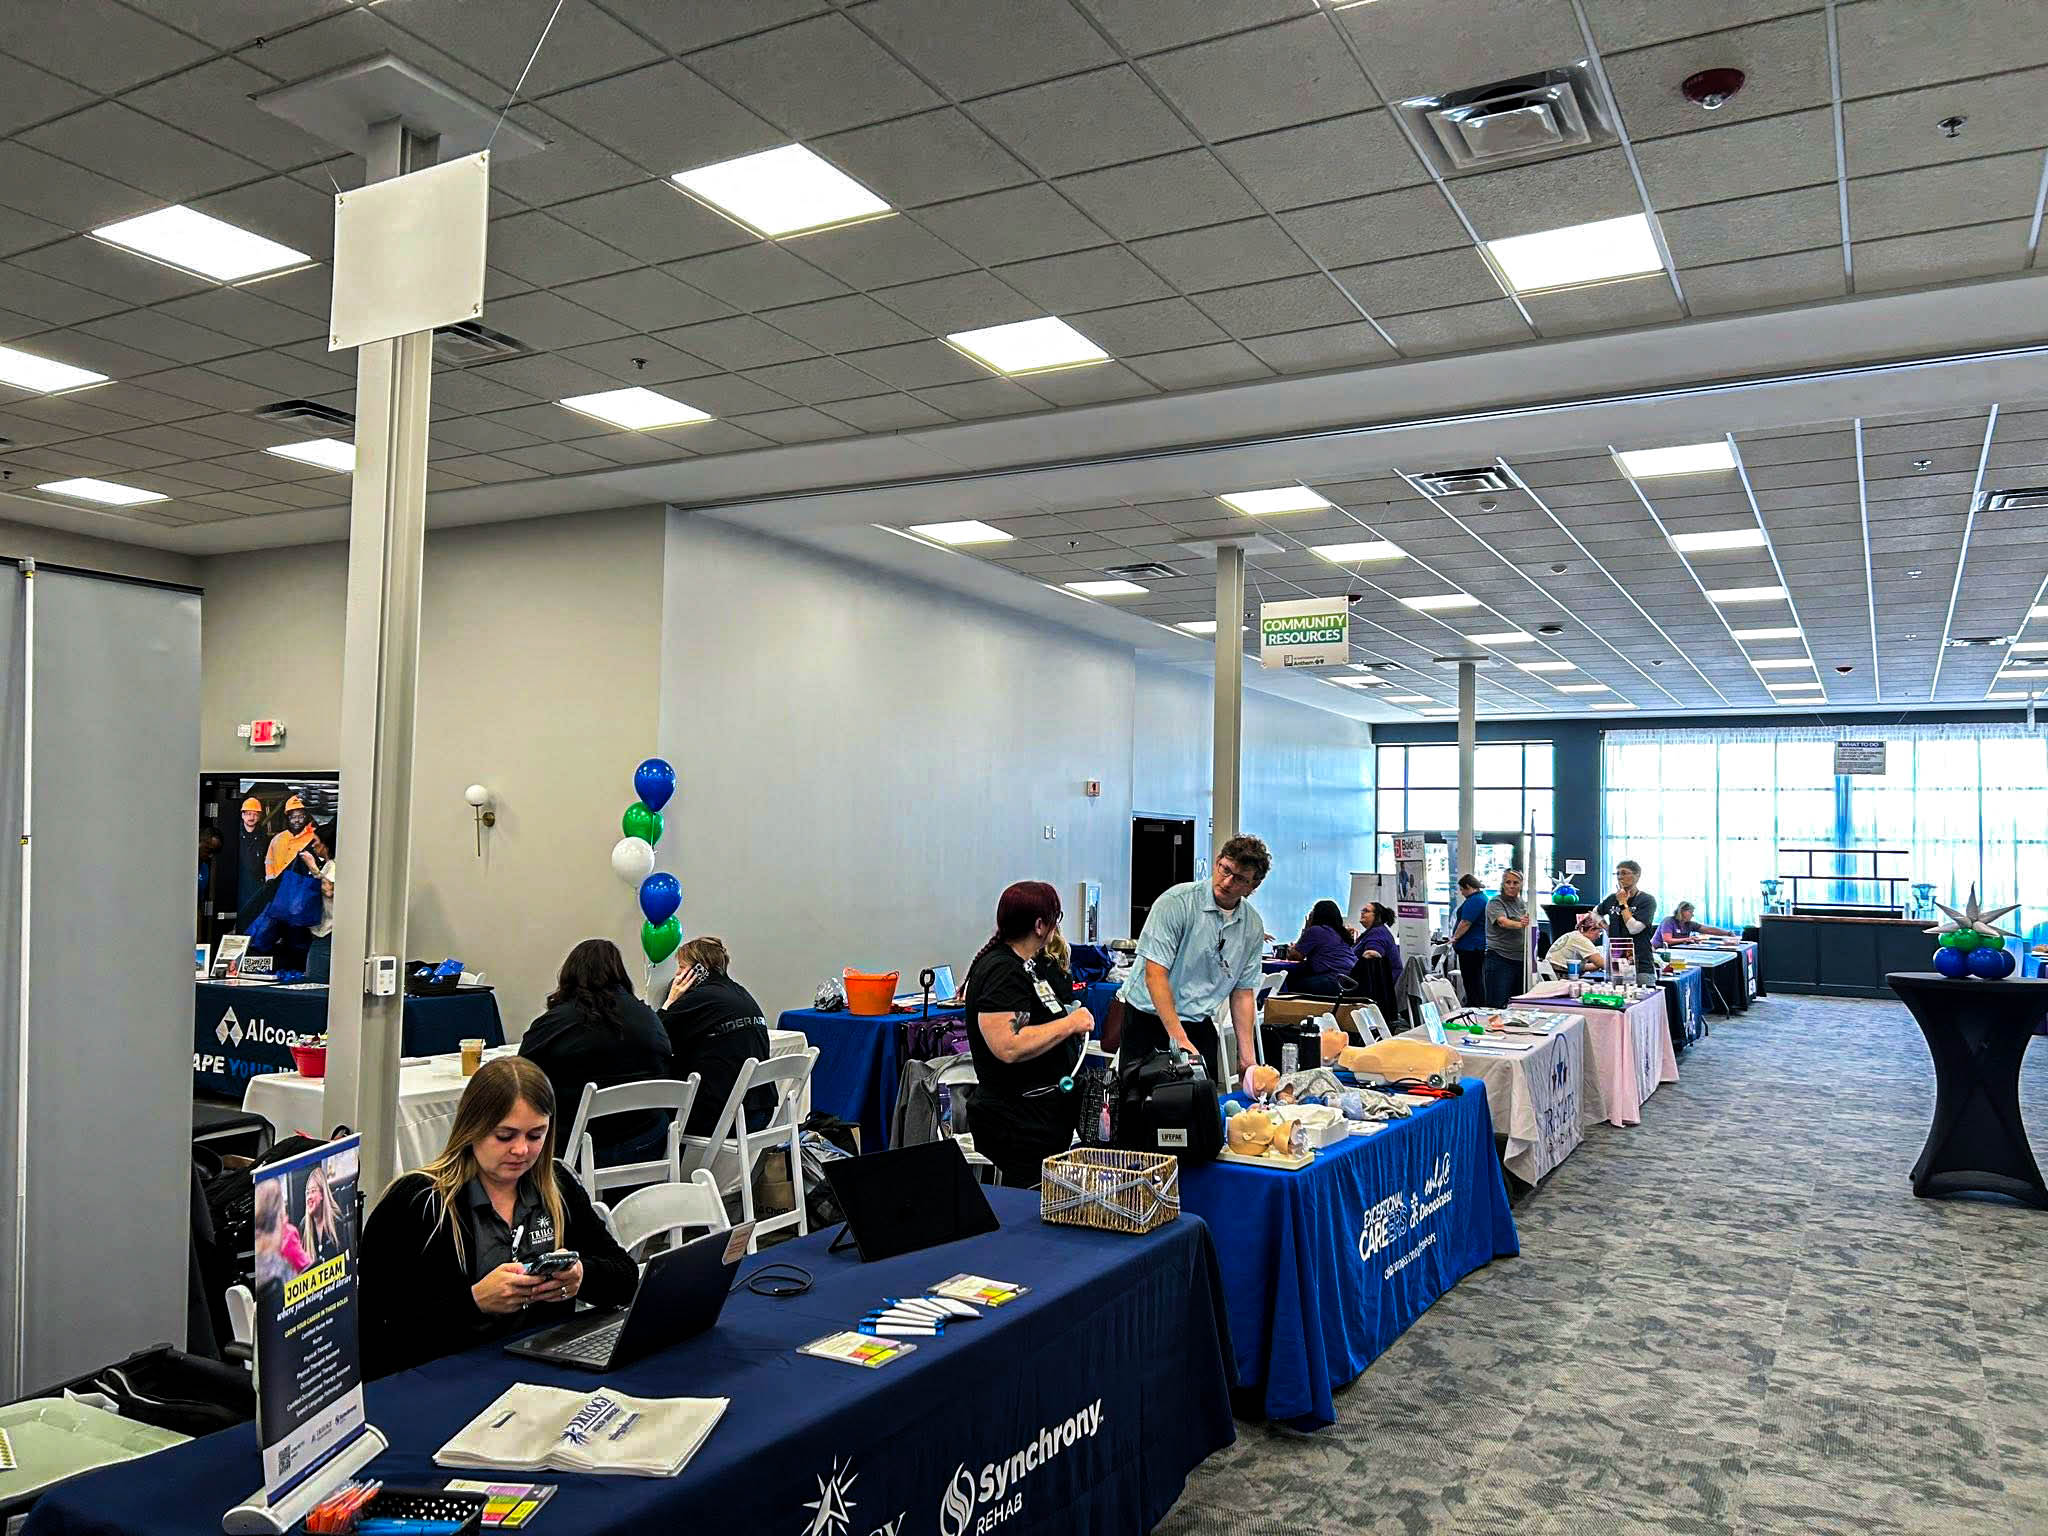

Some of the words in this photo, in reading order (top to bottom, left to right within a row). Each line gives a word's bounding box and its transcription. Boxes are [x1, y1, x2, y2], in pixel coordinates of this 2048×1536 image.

[1264, 614, 1345, 632] COMMUNITY
[1268, 629, 1340, 645] RESOURCES
[245, 1019, 296, 1046] Alcoa
[192, 1053, 225, 1074] APE
[1364, 1191, 1404, 1229] EXCEPTIONAL
[1420, 1189, 1453, 1221] Deaconess
[529, 1228, 554, 1240] TRILO
[287, 1278, 309, 1301] JOIN
[311, 1274, 317, 1289] A
[318, 1261, 343, 1283] TEAM
[276, 1307, 294, 1322] where
[294, 1301, 305, 1315] you
[305, 1289, 324, 1305] belong
[324, 1282, 335, 1295] and
[977, 1398, 1103, 1503] Synchrony
[976, 1492, 1024, 1536] REHAB
